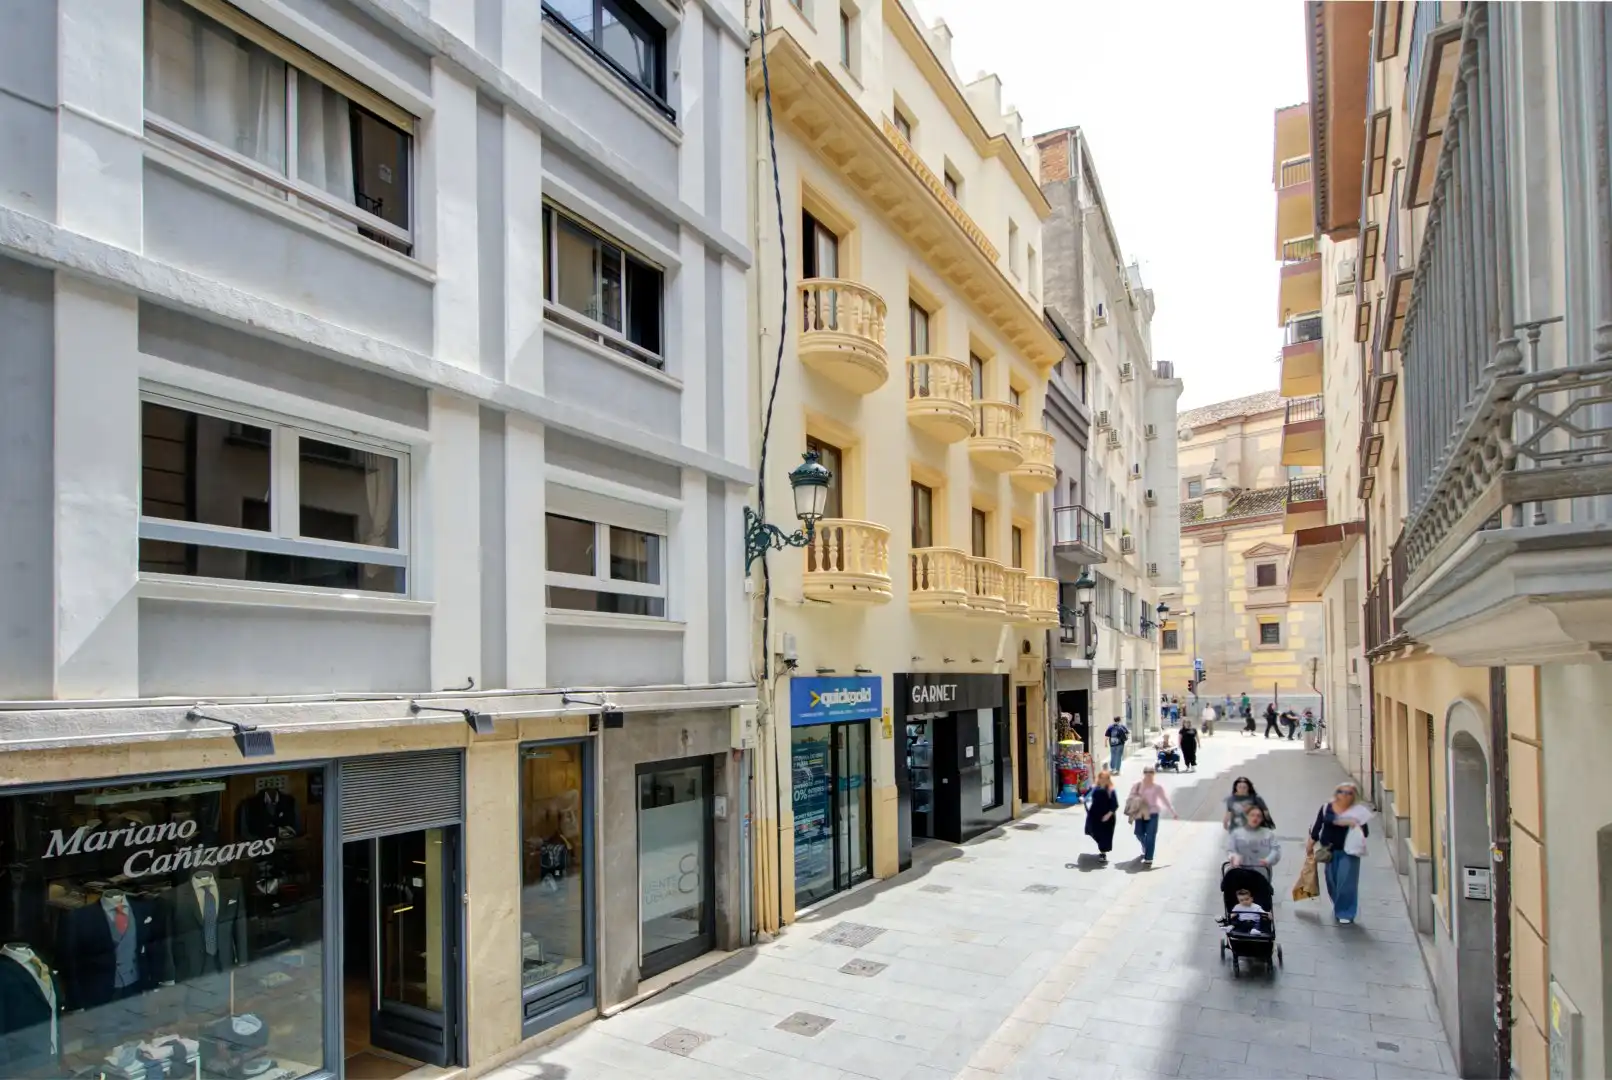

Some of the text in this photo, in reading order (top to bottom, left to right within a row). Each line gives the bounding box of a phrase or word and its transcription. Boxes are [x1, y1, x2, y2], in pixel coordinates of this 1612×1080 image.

[911, 684, 958, 703] GARNET
[41, 819, 198, 859] Mariano
[122, 836, 278, 879] Cañizares
